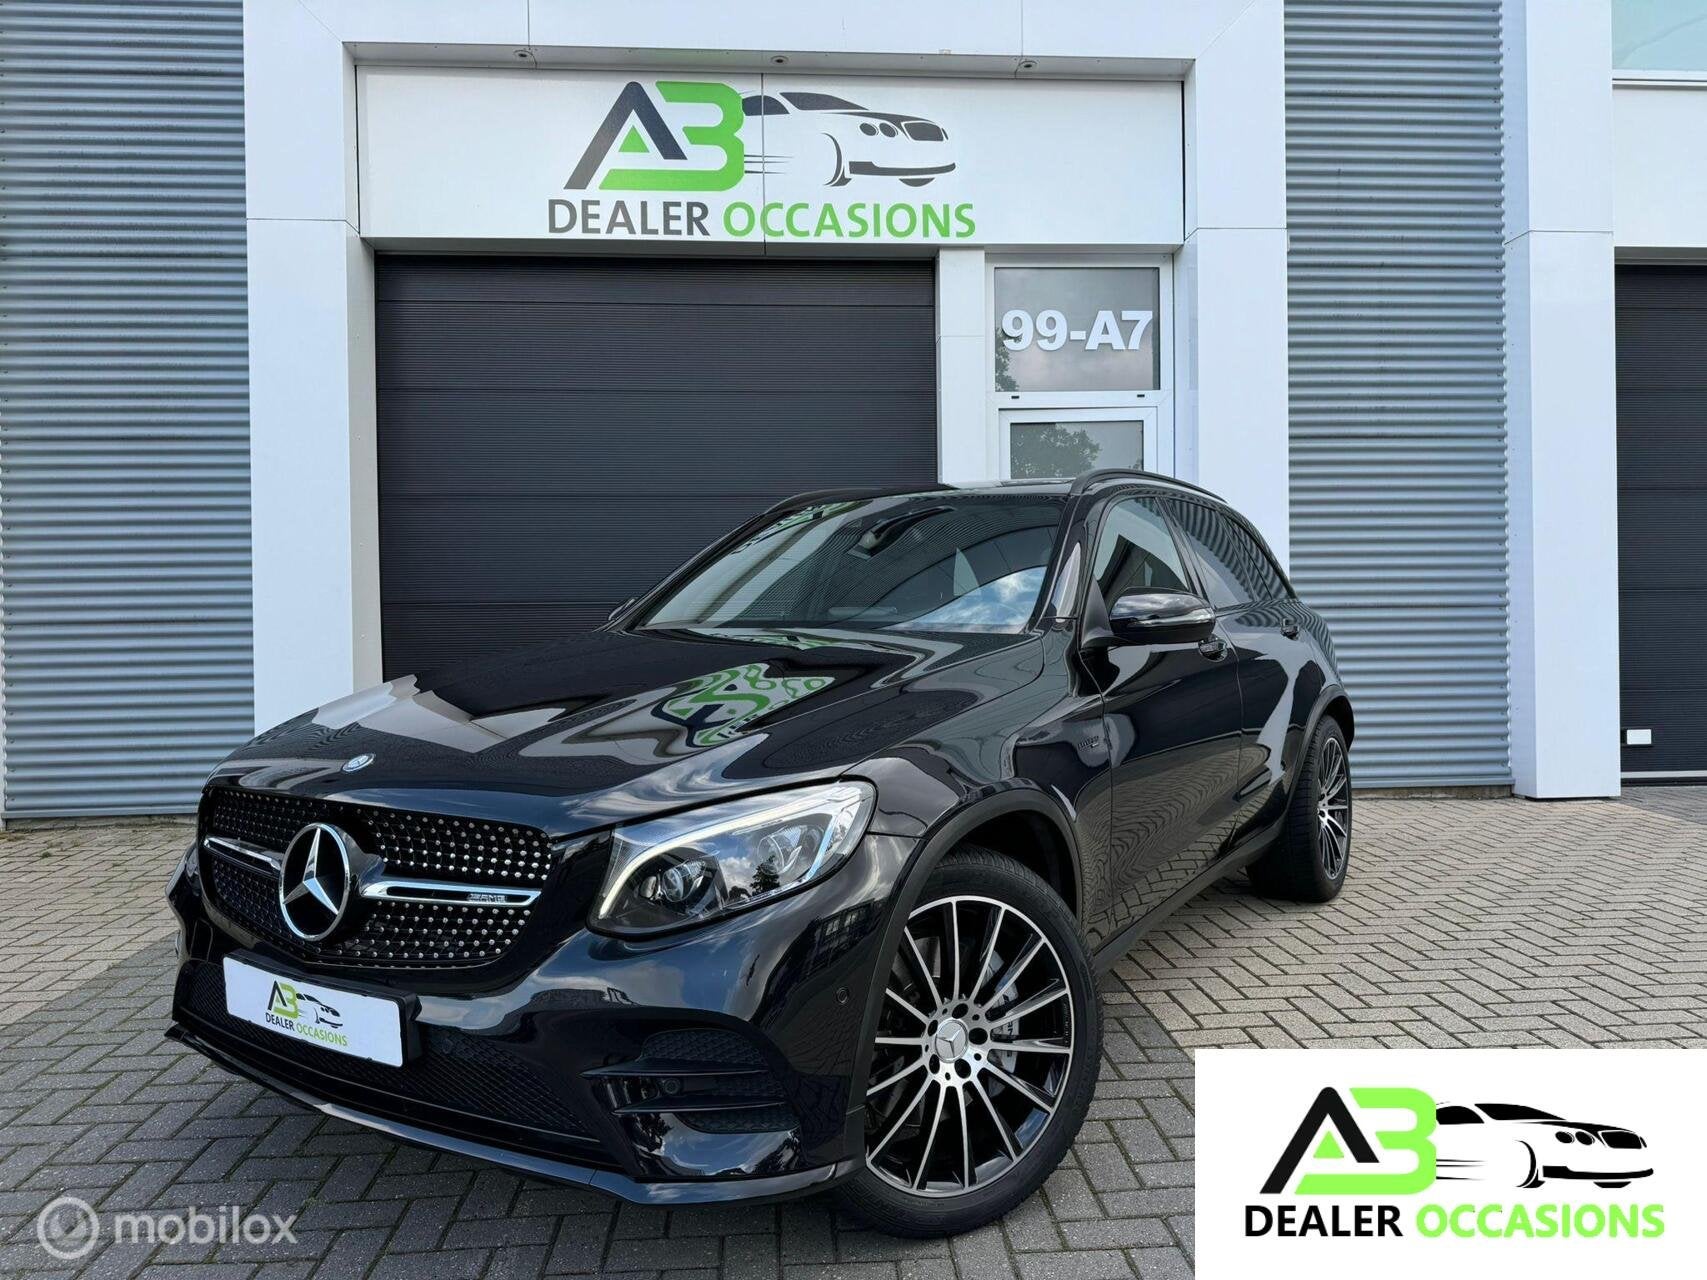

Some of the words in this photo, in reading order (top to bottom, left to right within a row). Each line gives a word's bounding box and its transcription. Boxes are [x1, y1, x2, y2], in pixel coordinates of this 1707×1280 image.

[563, 81, 745, 192] AB
[548, 199, 710, 237] DEALER
[723, 201, 976, 239] OCCASIONS
[1002, 309, 1153, 351] 99-A7
[265, 1012, 294, 1031] DEALER
[296, 1023, 347, 1046] OCCASIONS
